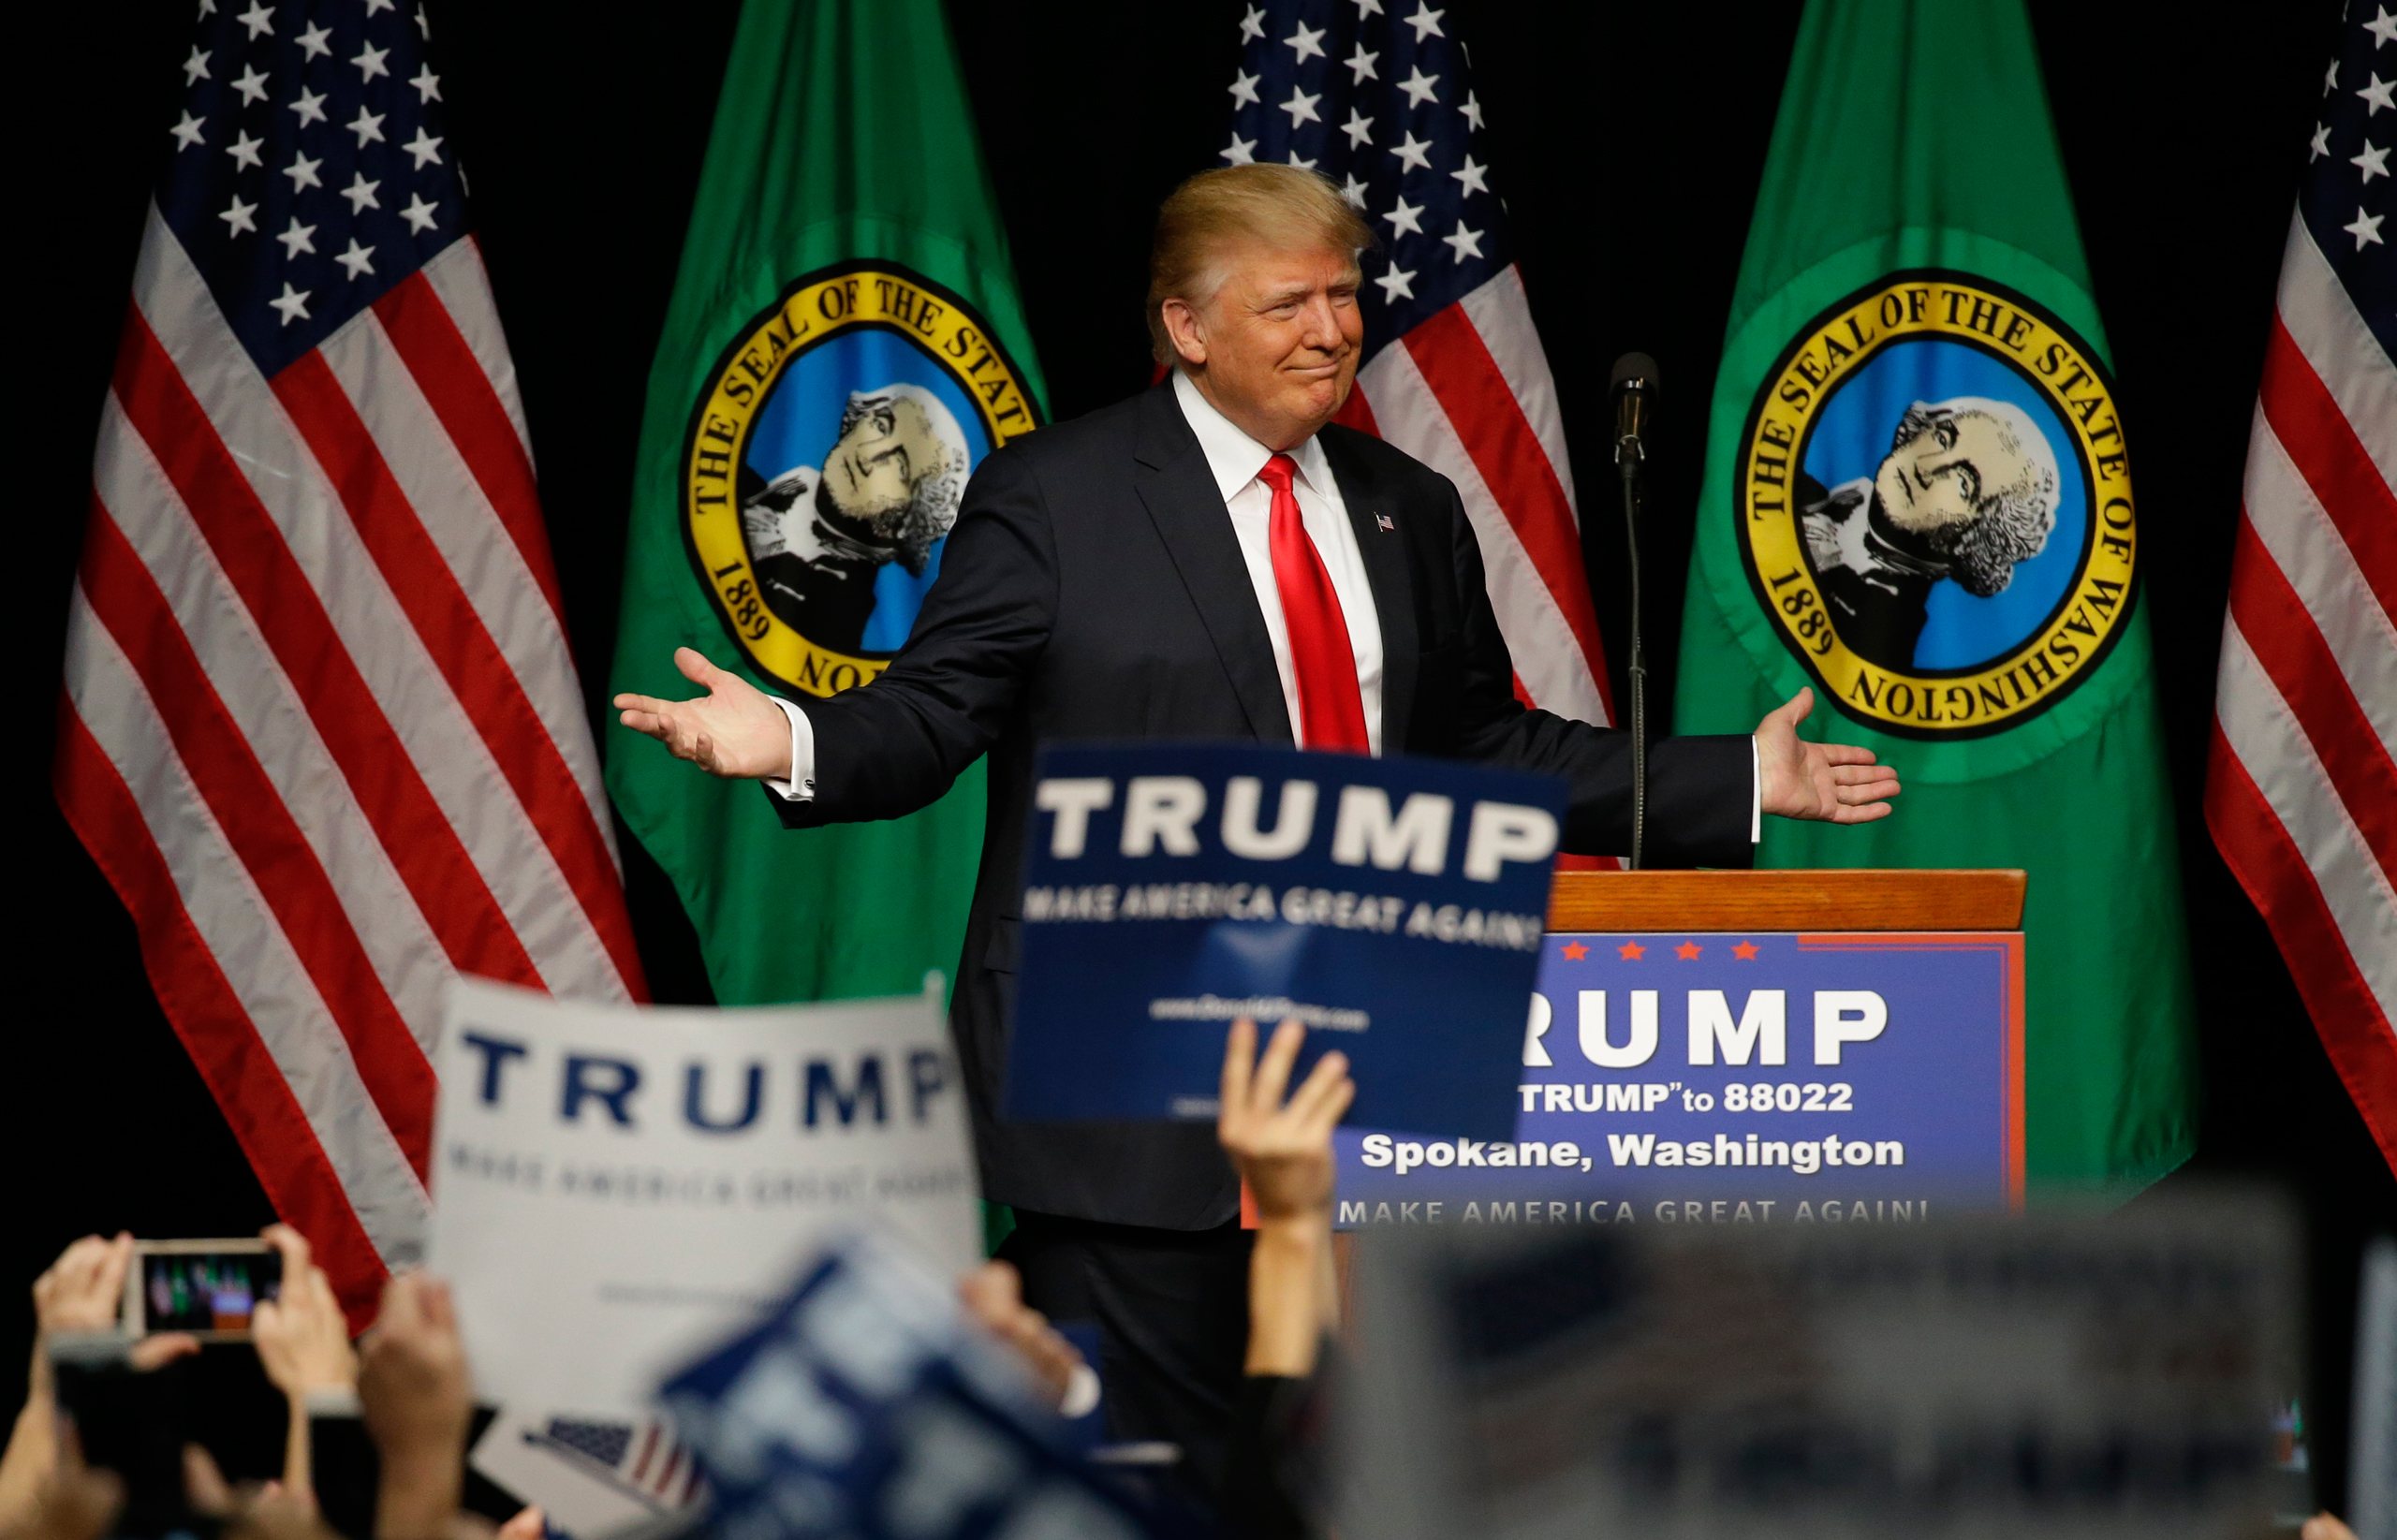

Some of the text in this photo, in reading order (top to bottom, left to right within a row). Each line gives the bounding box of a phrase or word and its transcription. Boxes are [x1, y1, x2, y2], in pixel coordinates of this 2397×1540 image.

[696, 279, 1028, 514] THE SEAL OF THE STAT
[1754, 288, 2133, 722] THE SEAL OF THE STATE OF WASHINGTON
[712, 558, 771, 641] 1889
[1770, 566, 1833, 656] 1889
[1036, 775, 1560, 883] TRUMP
[462, 1032, 953, 1135] TRUMP
[1683, 1089, 1714, 1112] to
[1724, 1082, 1853, 1112] 88022
[1360, 1134, 1904, 1175] Spokane, Washington
[1339, 1200, 1927, 1225] MAKE AMERICA GREAT AGAIN!
